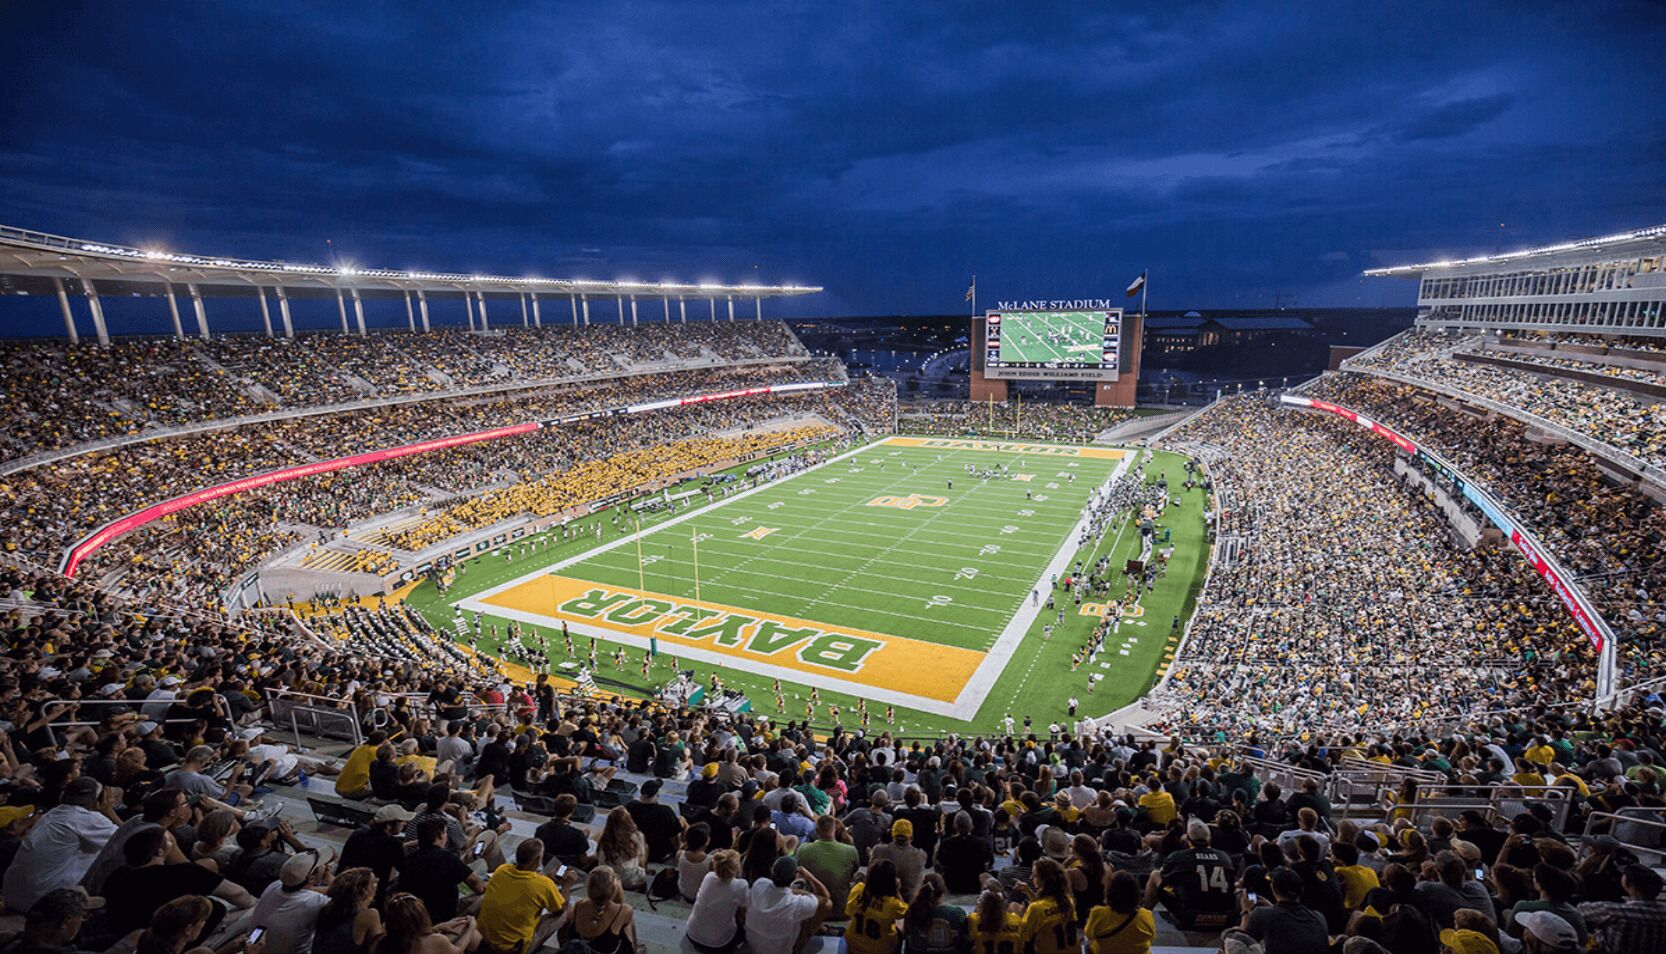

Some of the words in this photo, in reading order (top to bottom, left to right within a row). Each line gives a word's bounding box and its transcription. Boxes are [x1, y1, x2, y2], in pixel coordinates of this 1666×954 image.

[998, 301, 1047, 311] McLANE
[1050, 299, 1110, 309] STADIUM
[557, 588, 887, 674] BAYLOR
[1195, 852, 1219, 861] BEARS
[1195, 864, 1229, 893] 14
